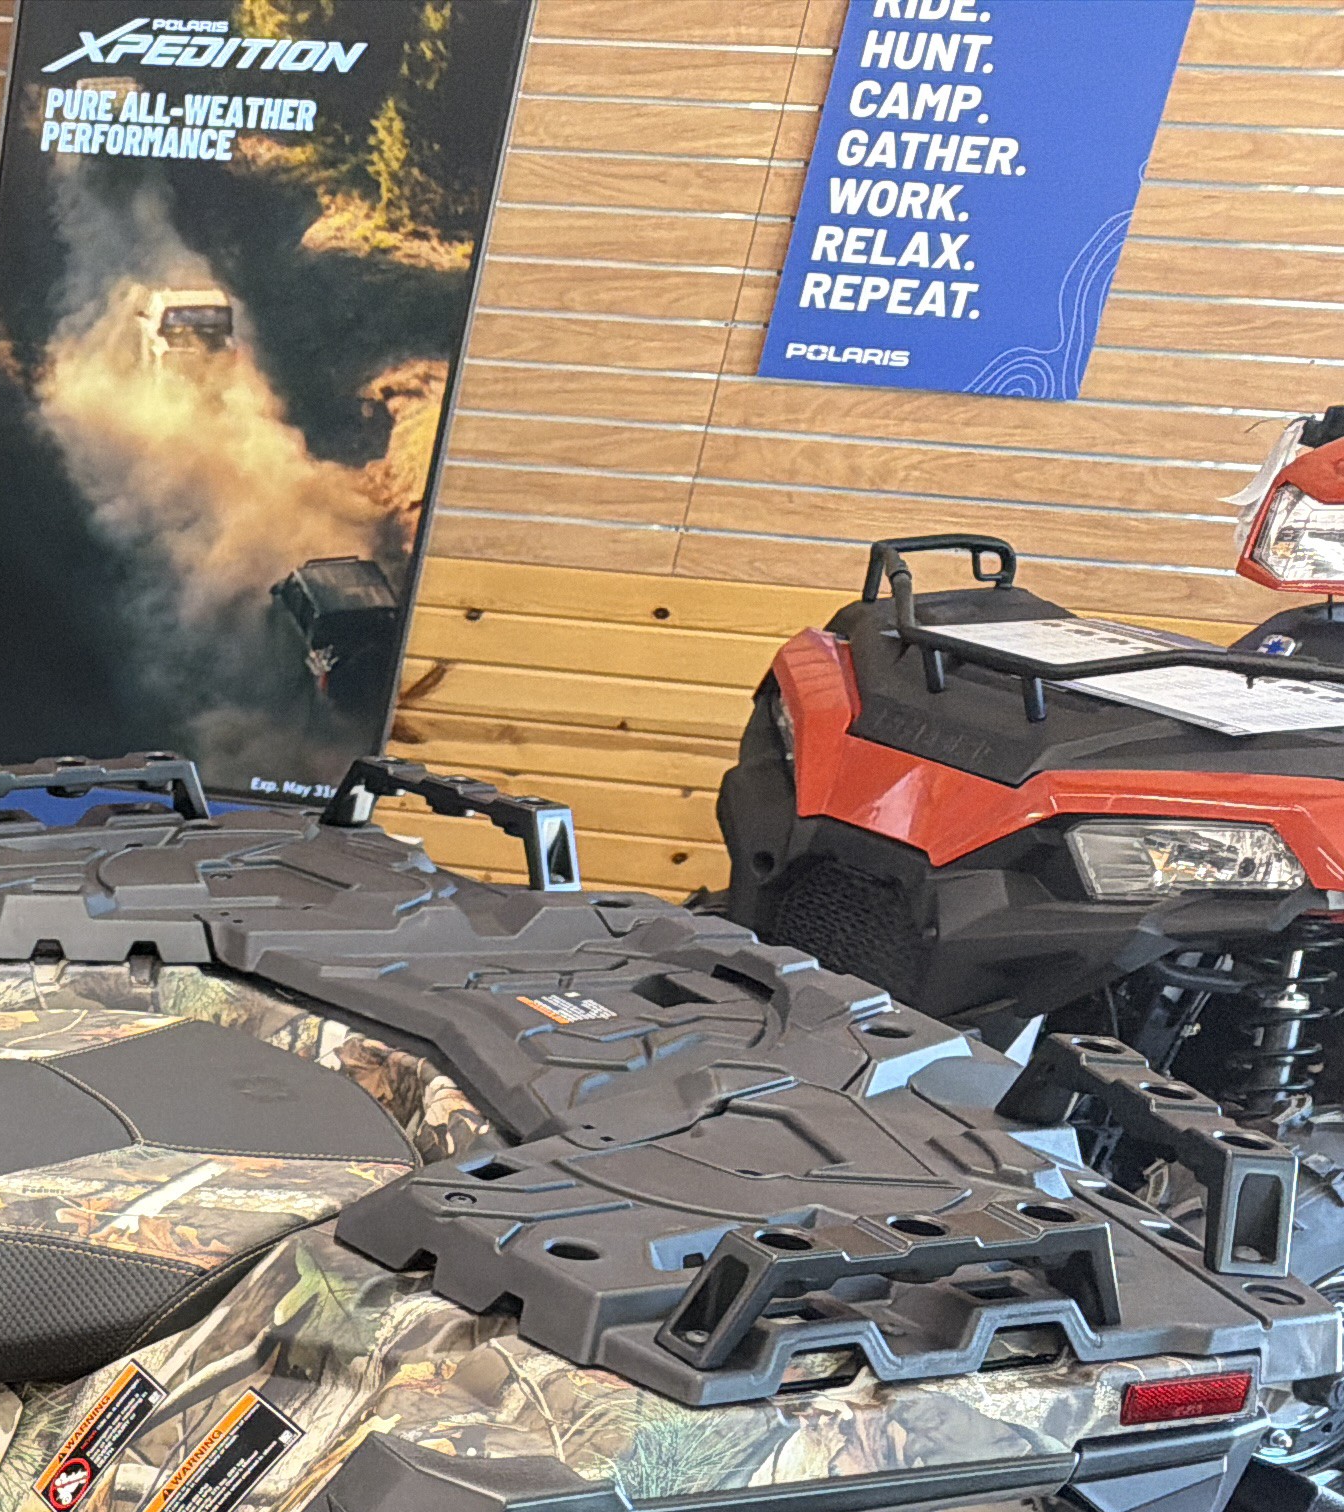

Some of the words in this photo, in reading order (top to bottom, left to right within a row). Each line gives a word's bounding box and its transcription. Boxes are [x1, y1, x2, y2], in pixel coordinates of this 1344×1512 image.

[41, 18, 368, 73] XPEDITION
[152, 18, 229, 33] POLARIS
[860, 30, 994, 74] HUNT.
[45, 87, 117, 122] PURE
[119, 91, 318, 131] ALL-WEATHER
[849, 79, 990, 125] CAMP.
[41, 122, 236, 160] PERFORMANCE
[837, 129, 1026, 176] GATHER.
[830, 177, 969, 223] WORK.
[811, 225, 975, 272] RELAX.
[799, 272, 980, 320] REPEAT.
[785, 342, 910, 368] POLARIS
[251, 777, 280, 794] Exp.
[283, 780, 312, 798] May
[65, 1395, 112, 1451] WARNING
[175, 1428, 224, 1487] WARNING
